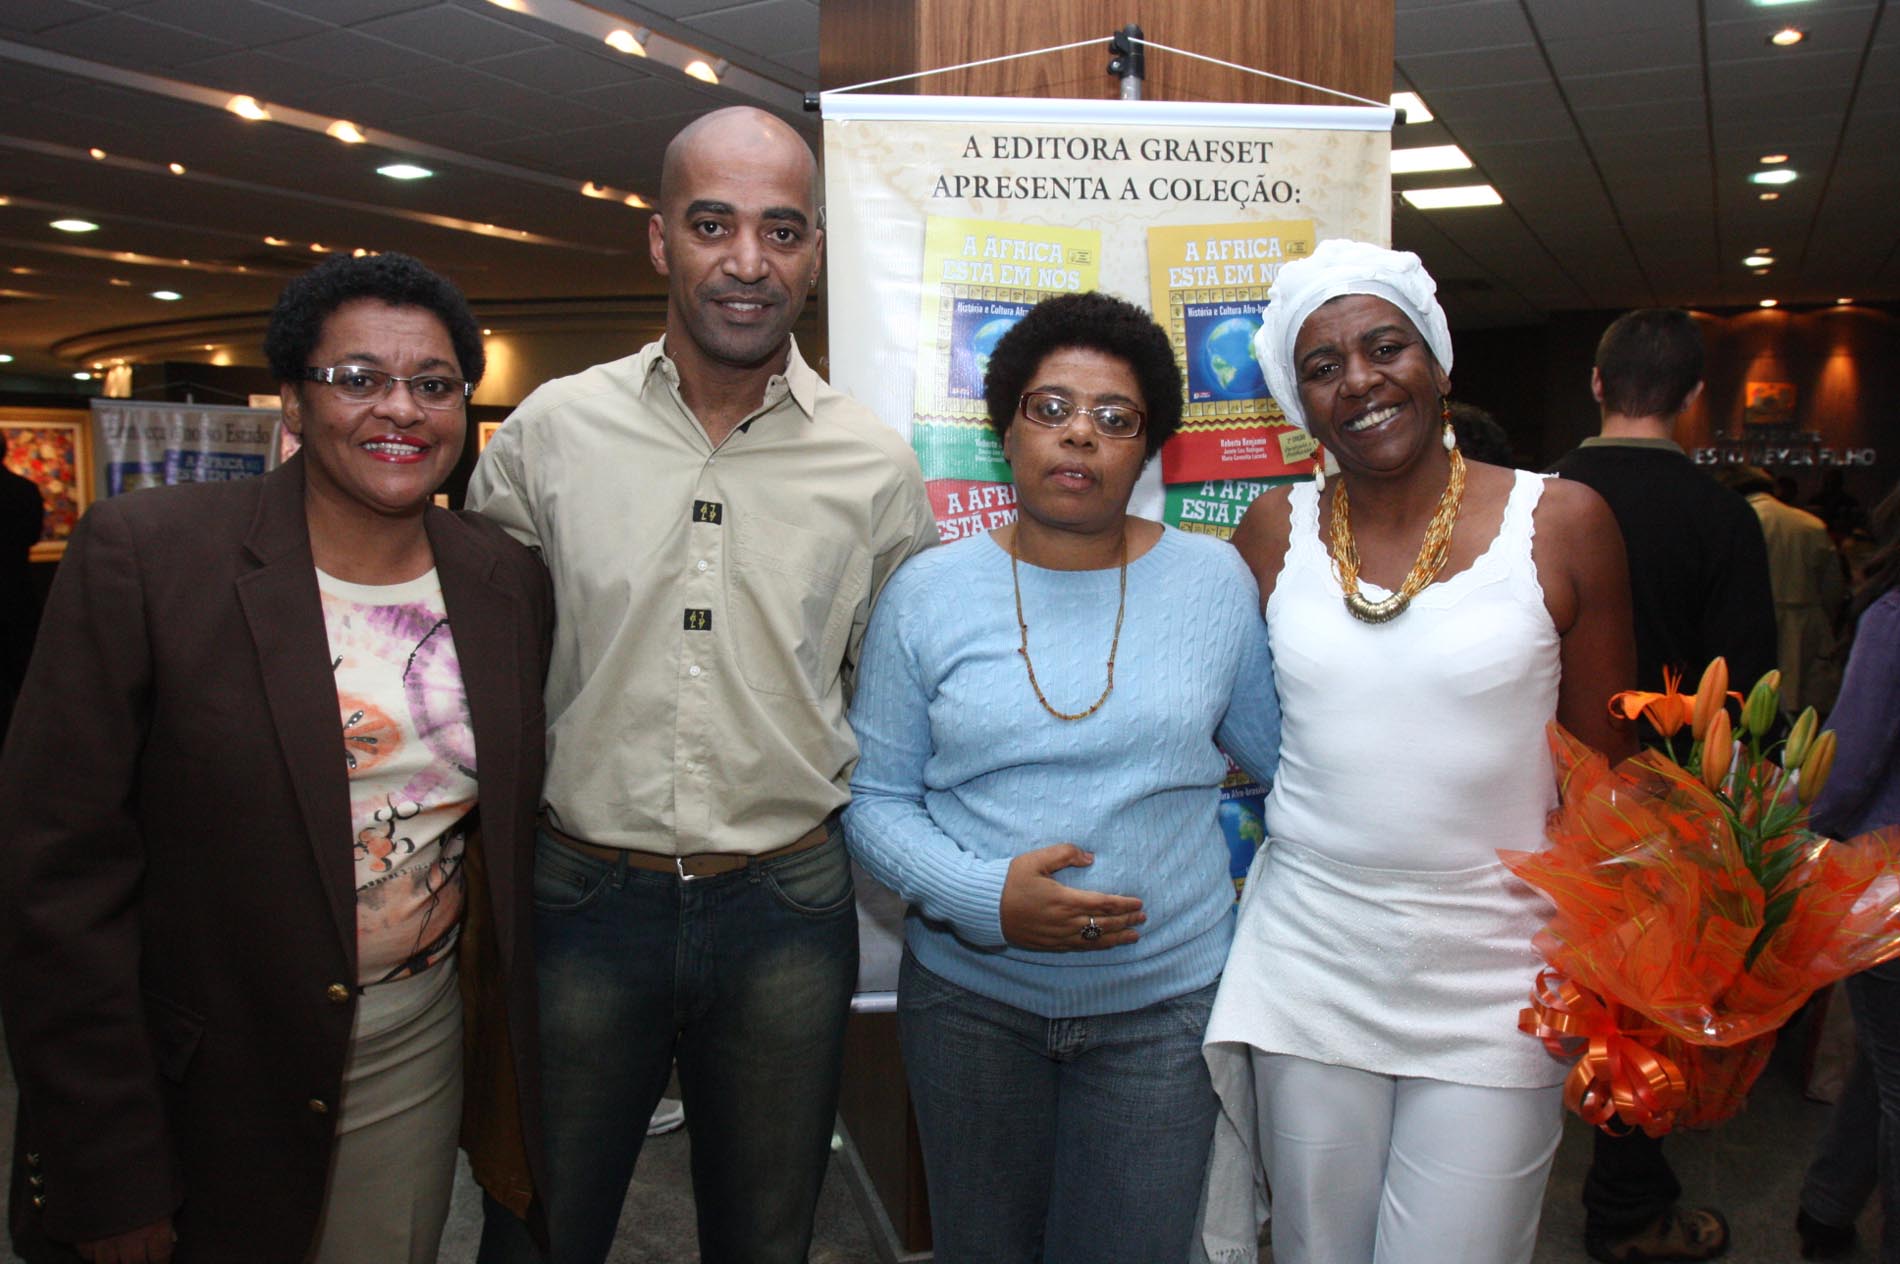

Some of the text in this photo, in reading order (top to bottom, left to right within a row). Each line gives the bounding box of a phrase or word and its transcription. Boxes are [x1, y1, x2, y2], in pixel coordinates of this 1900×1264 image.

[962, 134, 1273, 164] A EDITORA GRAFSET
[932, 173, 1301, 210] APRESENTA A COLEÇÃO:
[962, 235, 979, 257] A
[983, 234, 1064, 265] ÁFRICA
[1184, 240, 1200, 262] A
[1205, 237, 1282, 262] ÁFRICA
[943, 259, 1081, 290] ESTÁ EM NÓS
[1168, 259, 1283, 288] ESTÁ EM NÓ
[957, 301, 983, 315] História
[990, 303, 1014, 316] Cultura
[1015, 305, 1031, 316] Afr
[1187, 306, 1213, 318] História
[1219, 305, 1242, 316] Cultura
[1819, 447, 1877, 466] FILHO
[1200, 479, 1215, 497] A
[946, 492, 964, 514] A
[1180, 498, 1230, 523] ESTÁ
[936, 508, 1019, 541] ESTÁ EM
